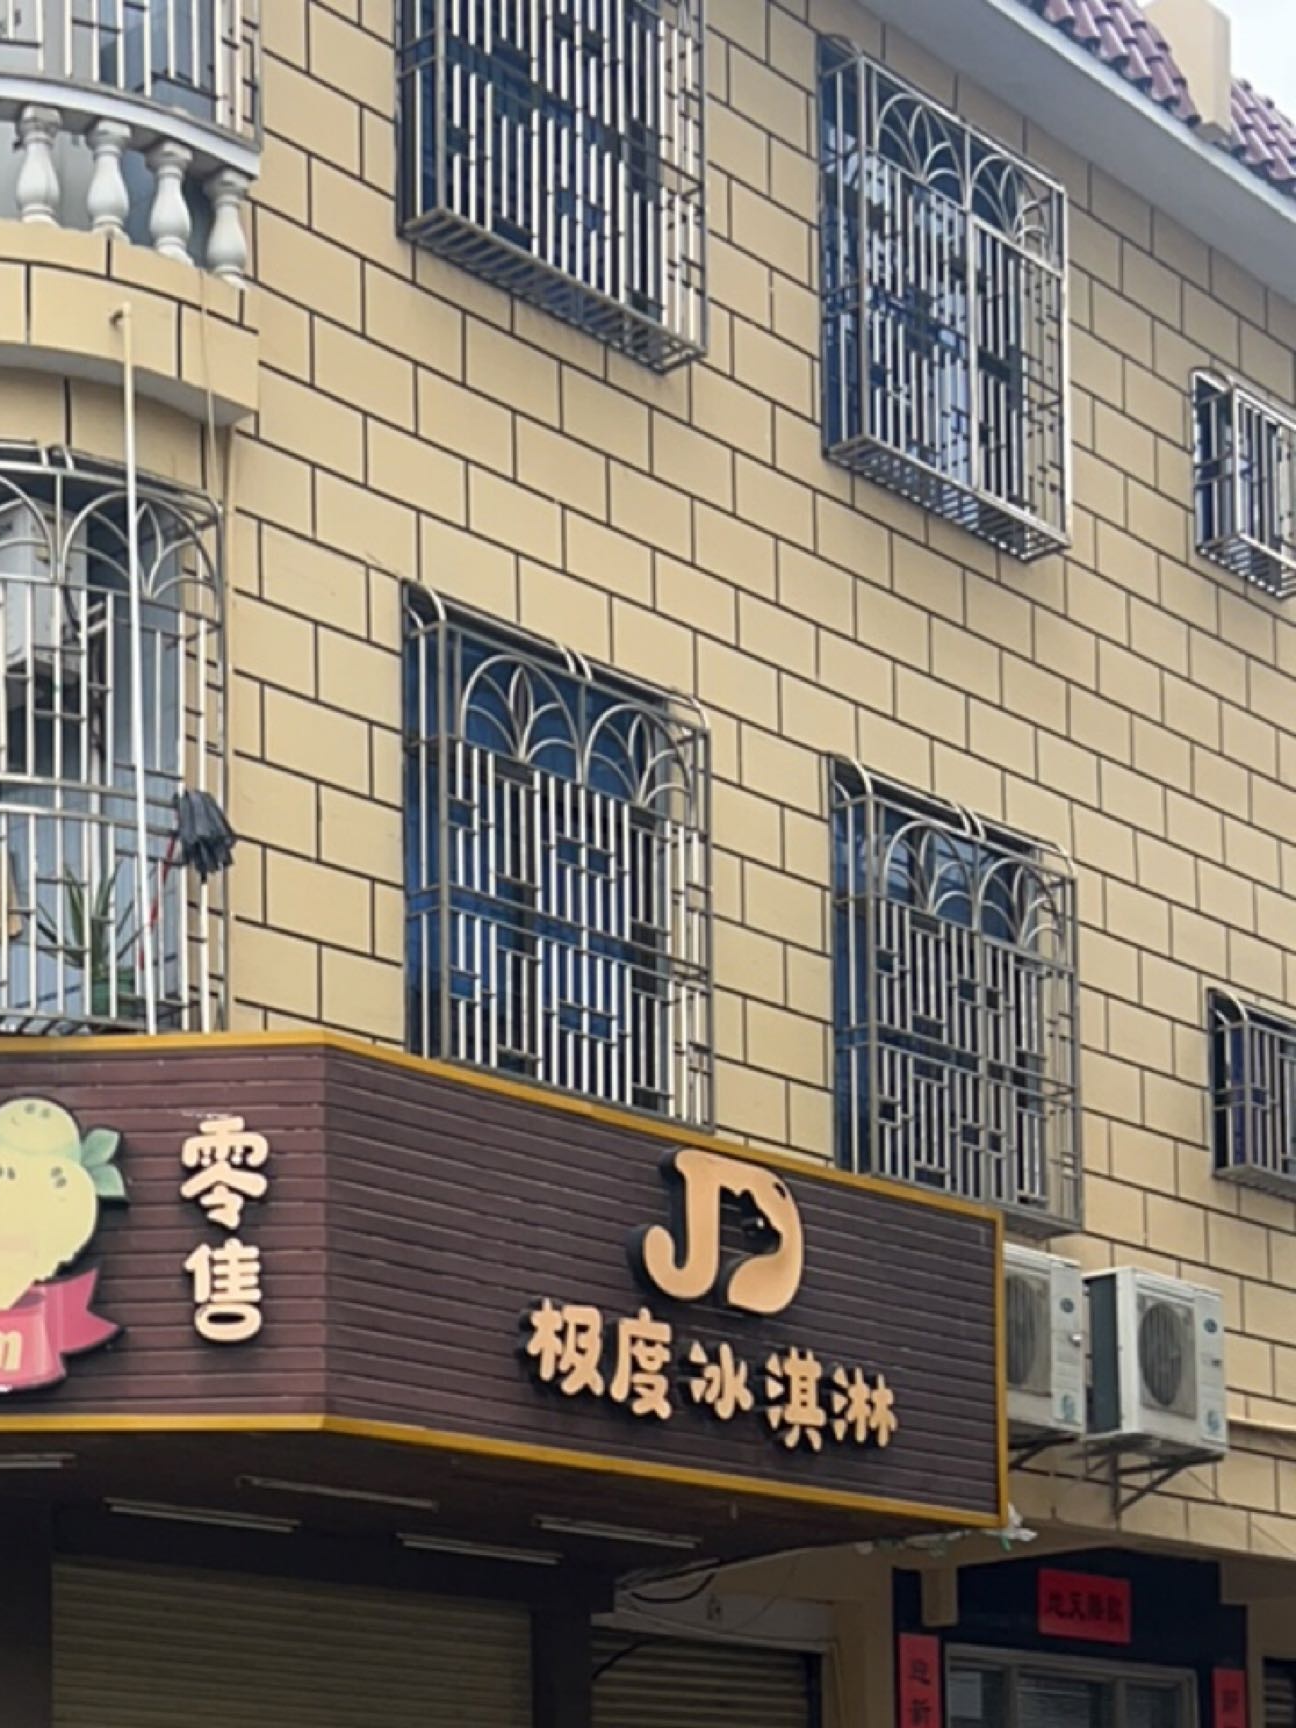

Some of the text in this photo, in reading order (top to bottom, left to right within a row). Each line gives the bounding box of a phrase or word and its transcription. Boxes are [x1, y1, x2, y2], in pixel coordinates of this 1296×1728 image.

[181, 1116, 270, 1344] 零售
[525, 1298, 899, 1452] 极度冰淇淋
